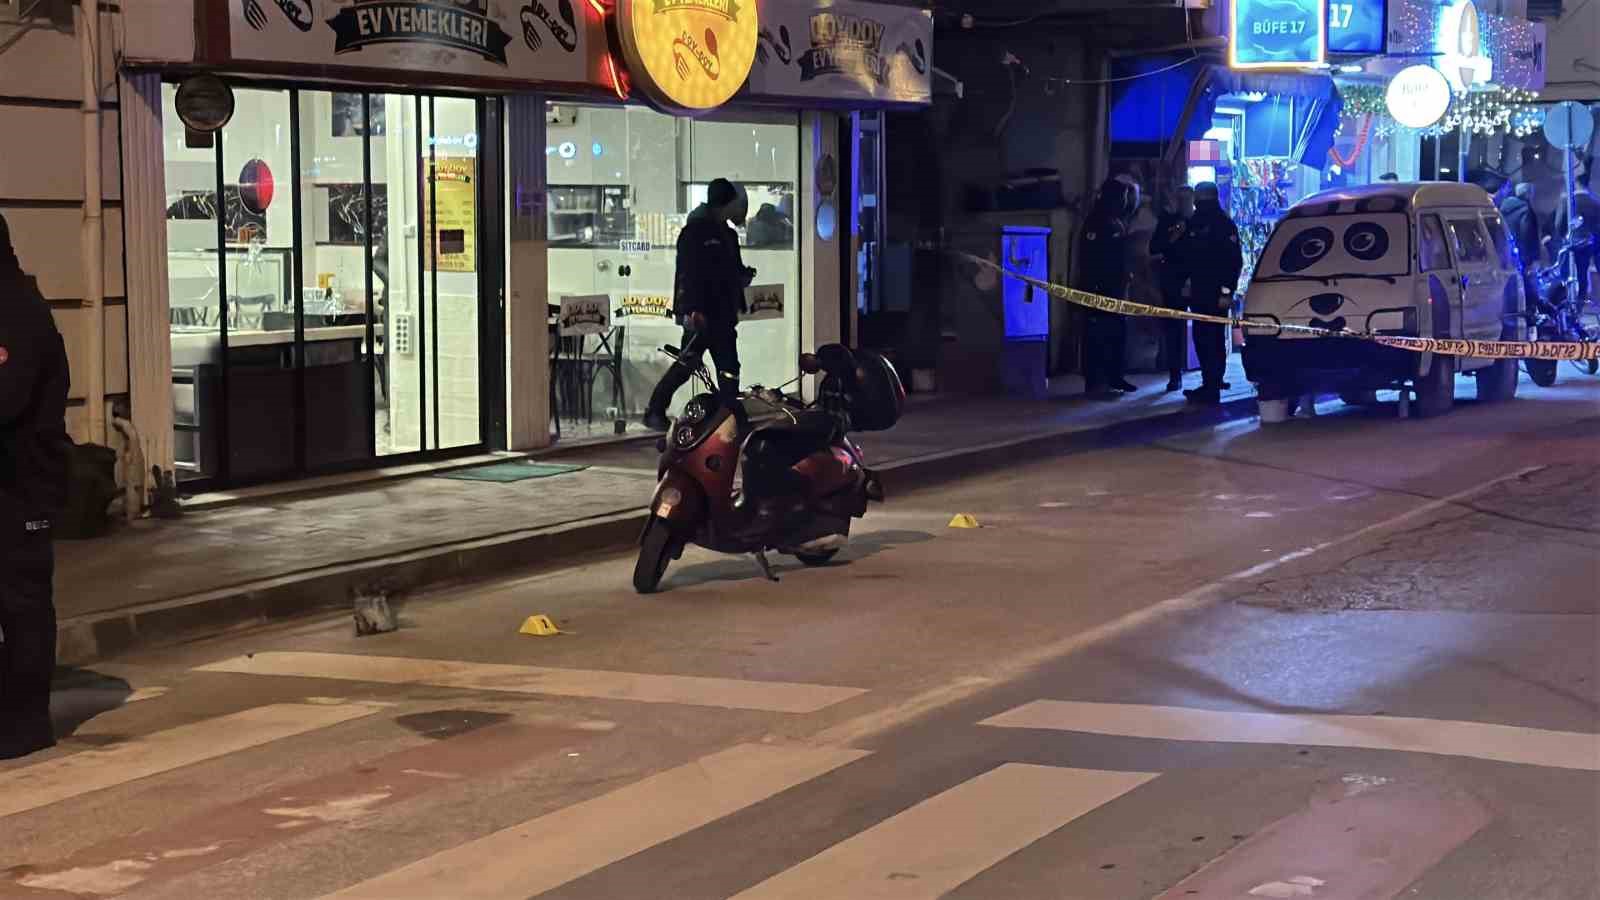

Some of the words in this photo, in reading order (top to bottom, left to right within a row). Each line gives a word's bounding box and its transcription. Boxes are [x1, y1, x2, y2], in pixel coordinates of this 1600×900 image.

[357, 8, 382, 35] EV
[386, 6, 488, 46] YEMEKLERİ
[1290, 21, 1305, 34] 17
[1329, 4, 1353, 28] 17
